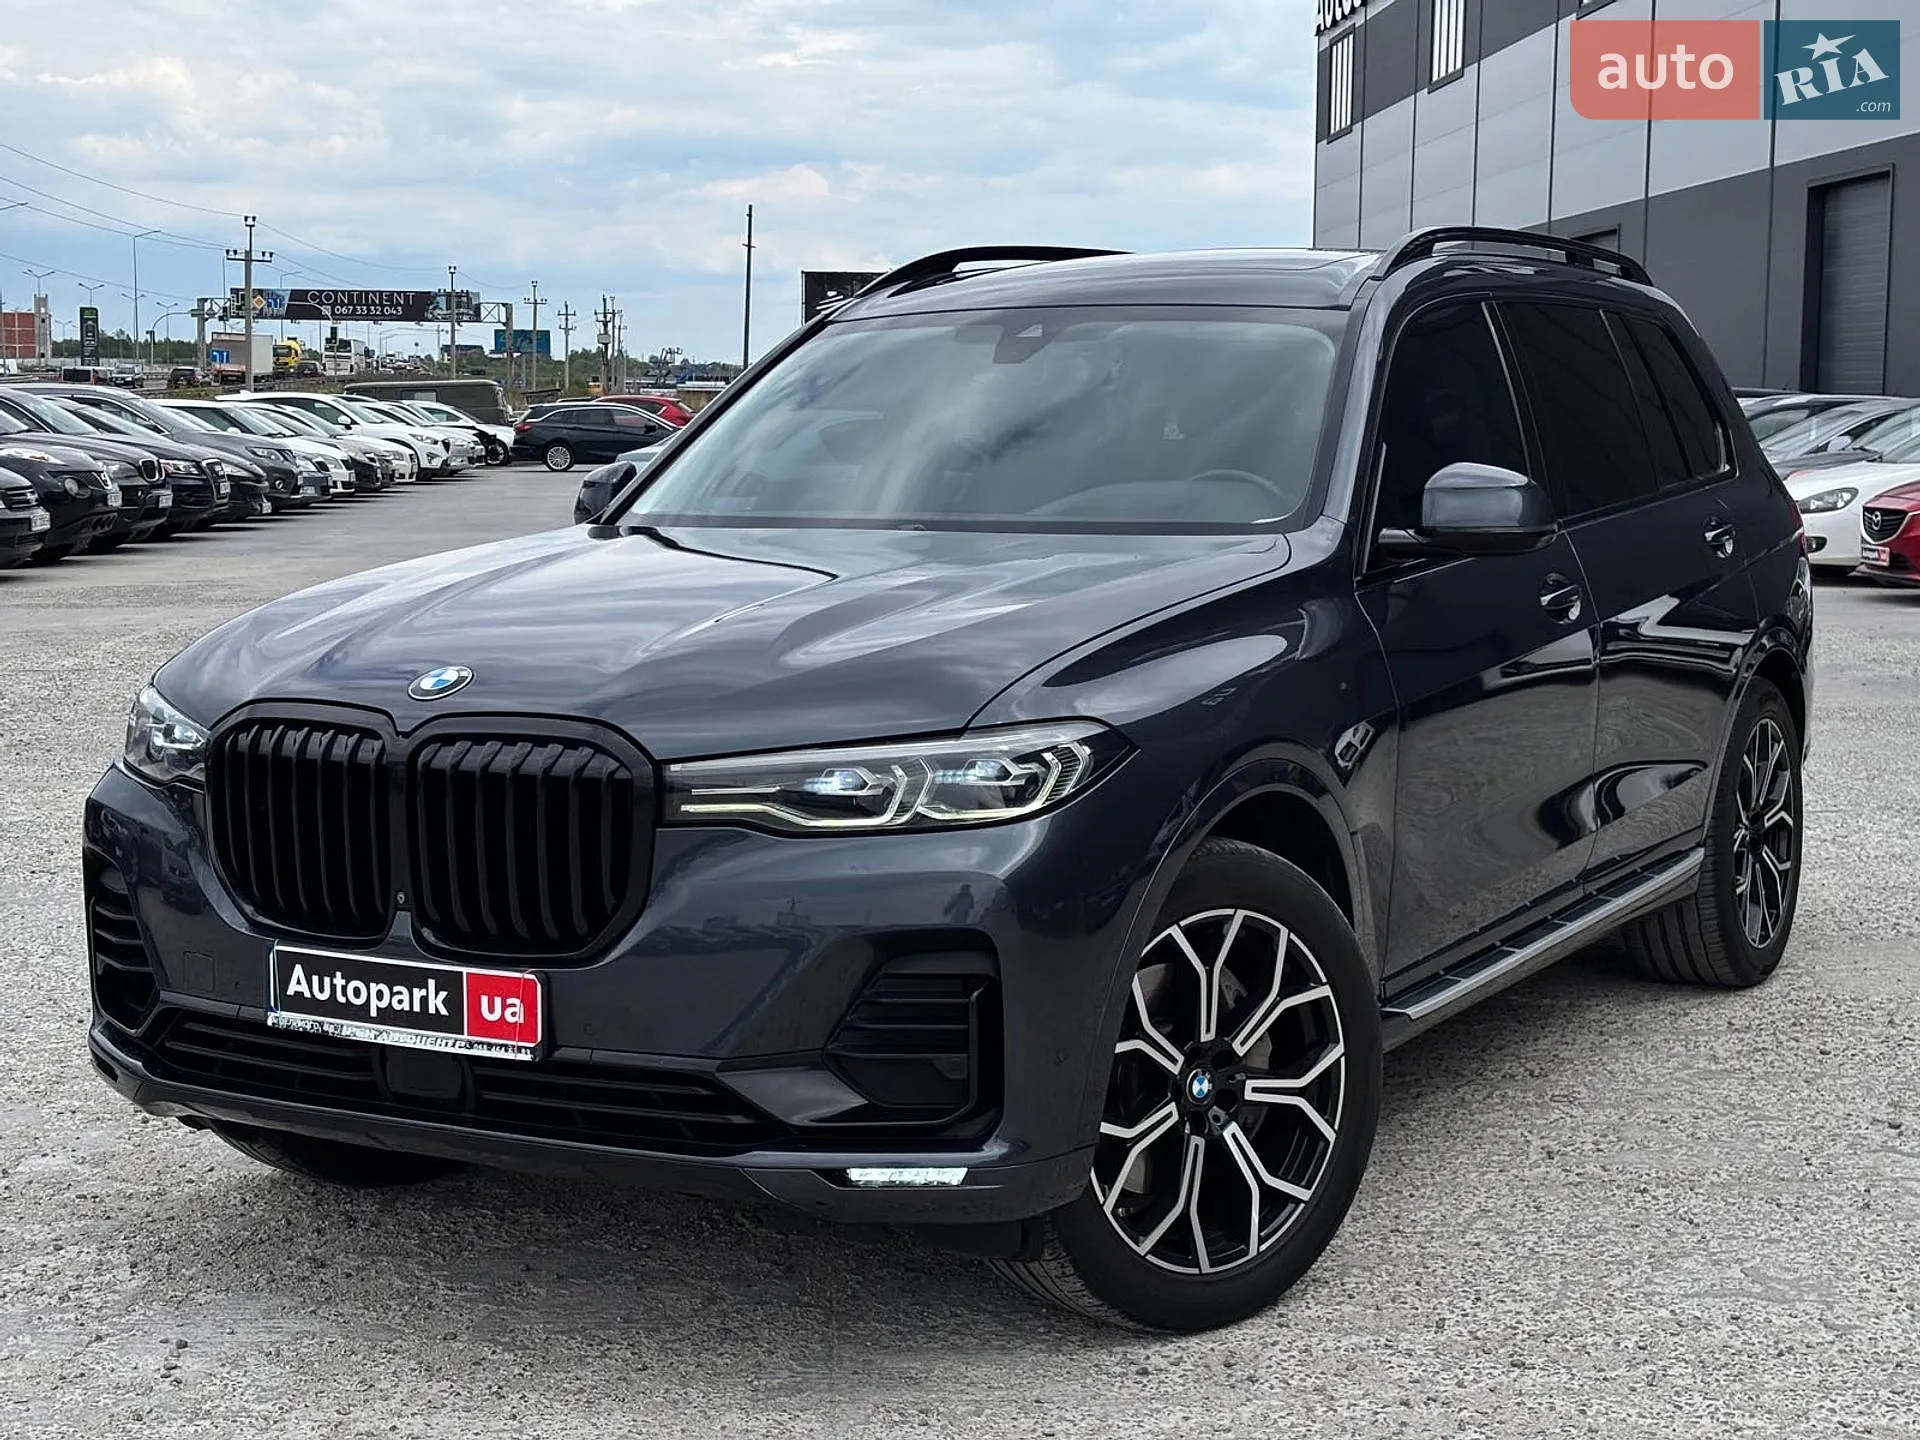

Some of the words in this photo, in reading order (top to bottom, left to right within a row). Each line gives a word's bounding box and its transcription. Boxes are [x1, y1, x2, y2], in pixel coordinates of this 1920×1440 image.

[307, 291, 415, 305] CONTINENT
[334, 306, 354, 315] 067
[355, 306, 368, 315] 33
[369, 306, 382, 315] 32
[286, 964, 449, 1017] Autopark
[480, 993, 525, 1025] ua
